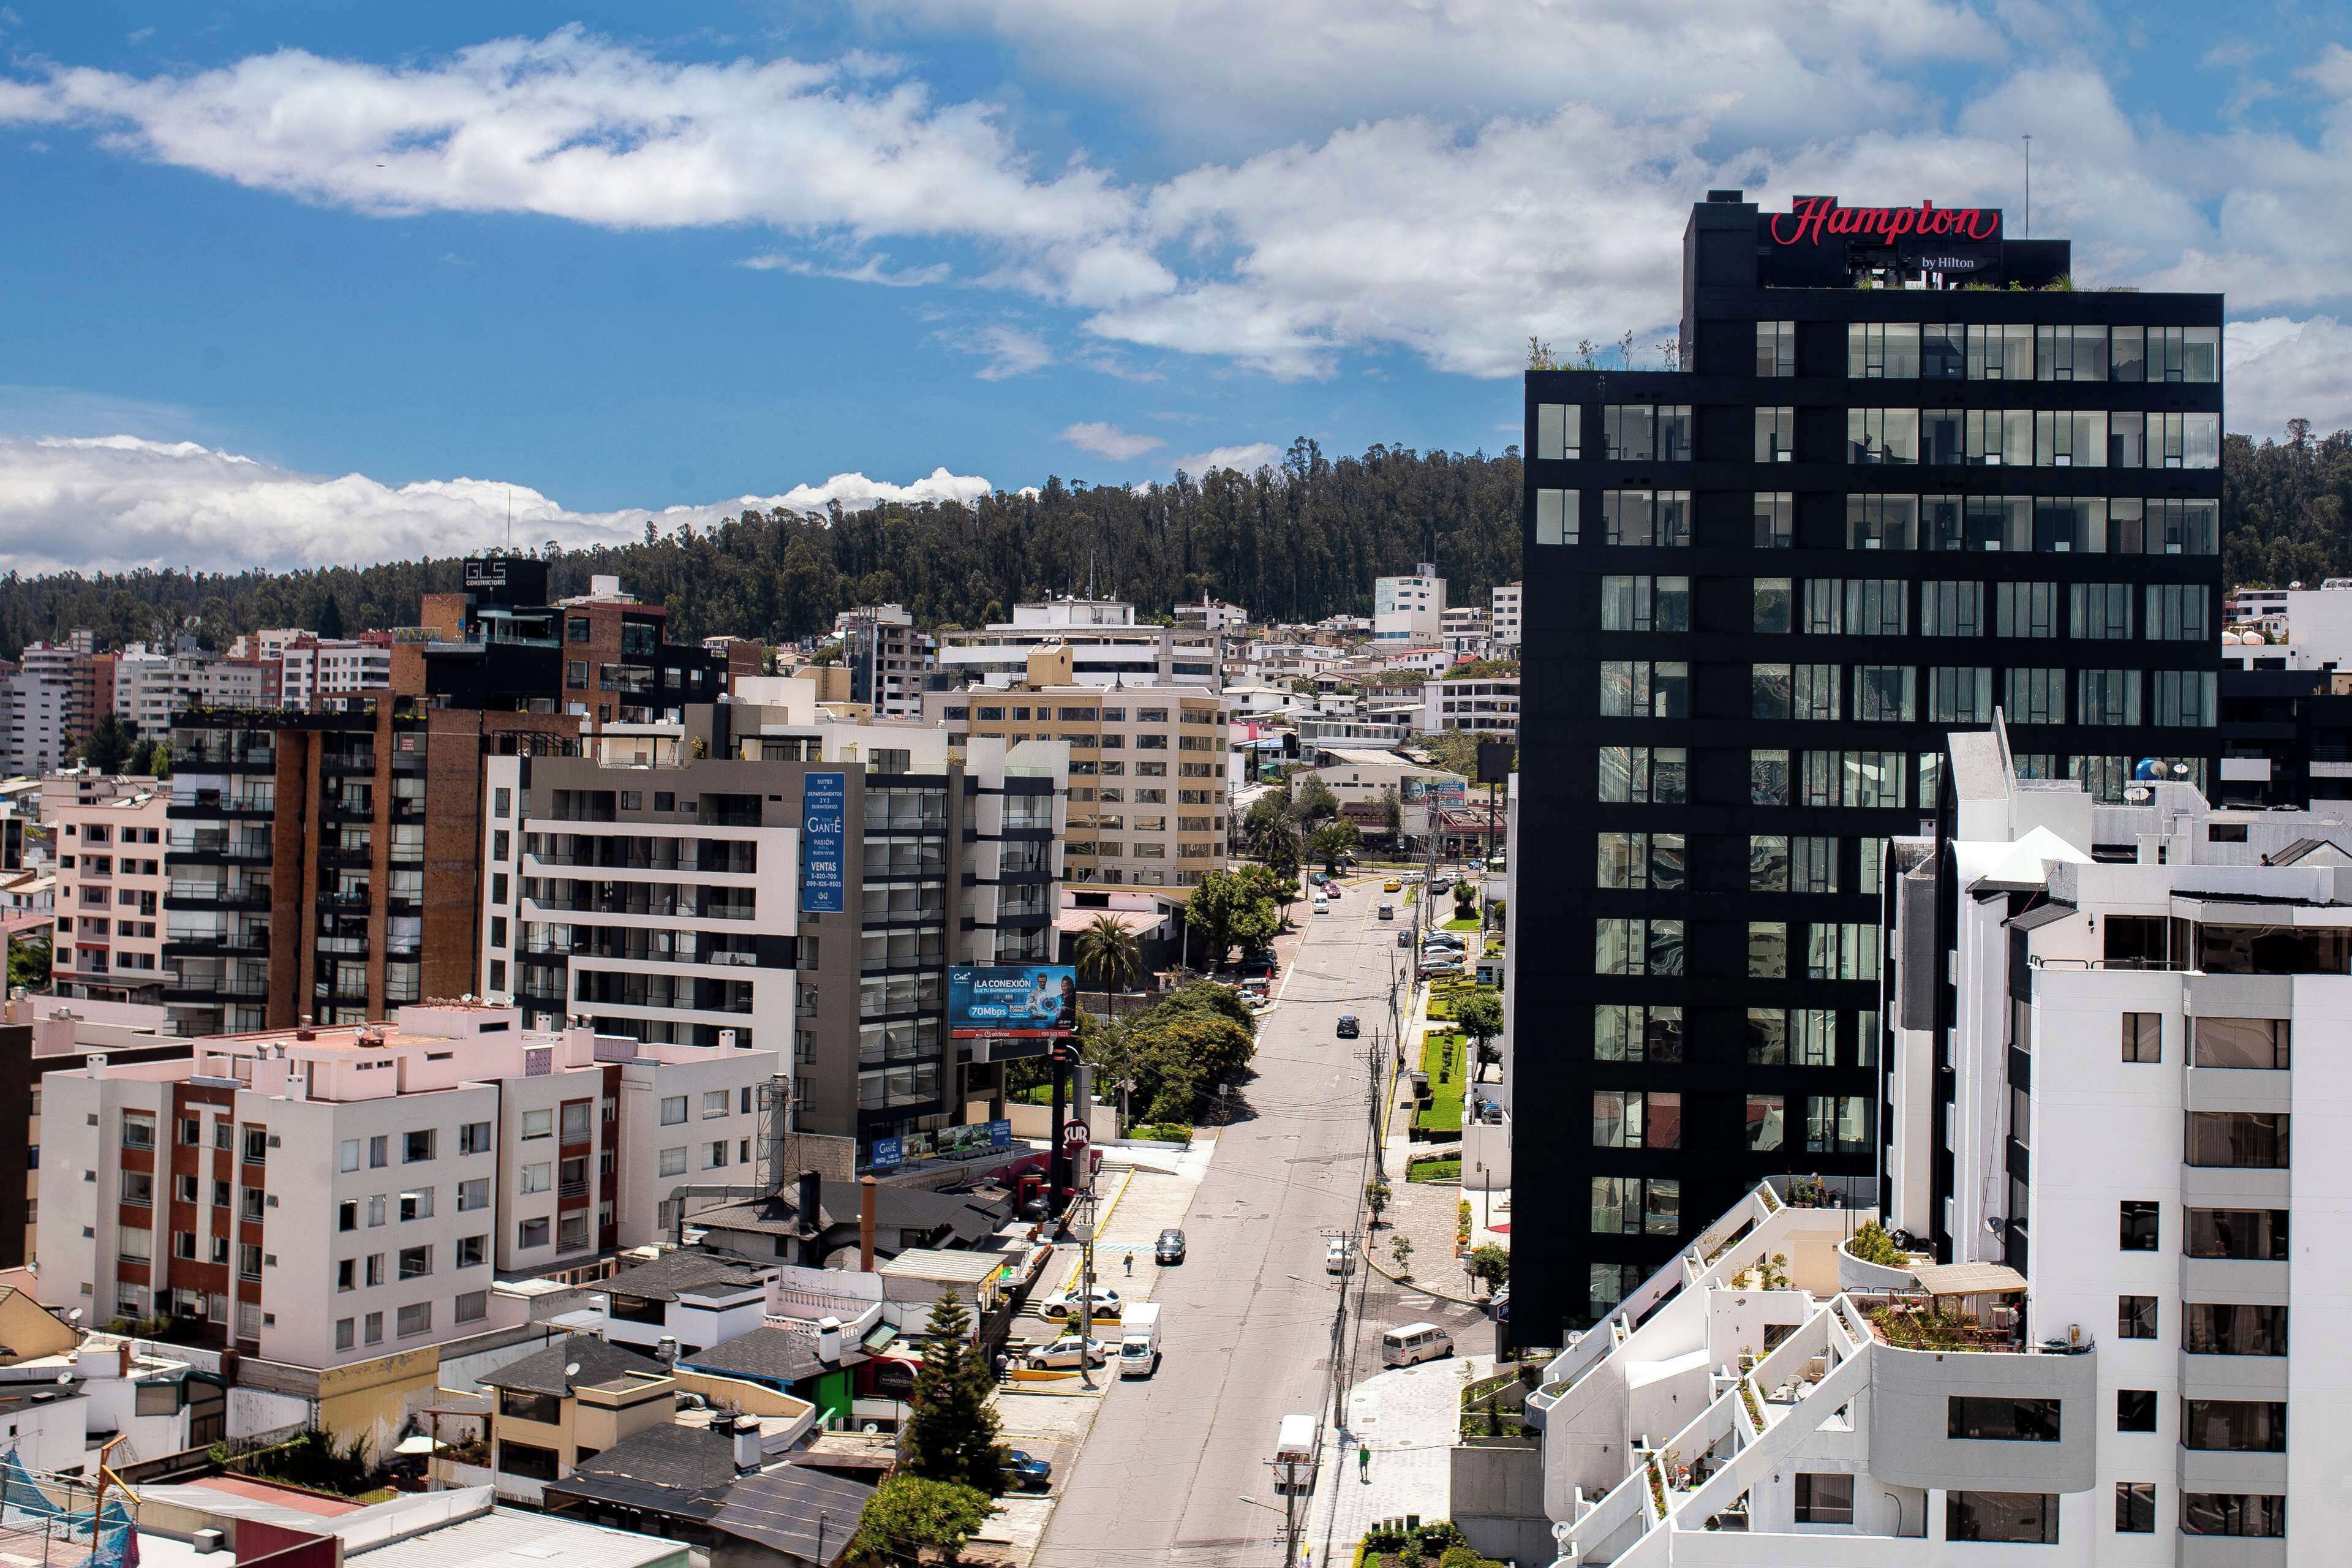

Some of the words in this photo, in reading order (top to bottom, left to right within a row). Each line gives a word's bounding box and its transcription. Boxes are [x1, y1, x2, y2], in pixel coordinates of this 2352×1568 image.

[1771, 196, 1999, 246] Hampton
[1922, 257, 1936, 270] by
[1938, 257, 1974, 268] Hilton
[466, 562, 506, 579] GLS
[811, 861, 837, 872] VENTAS
[989, 978, 1031, 987] CONEXIÓN
[971, 1007, 1006, 1017] 70Mbps
[1063, 1126, 1088, 1145] SUR
